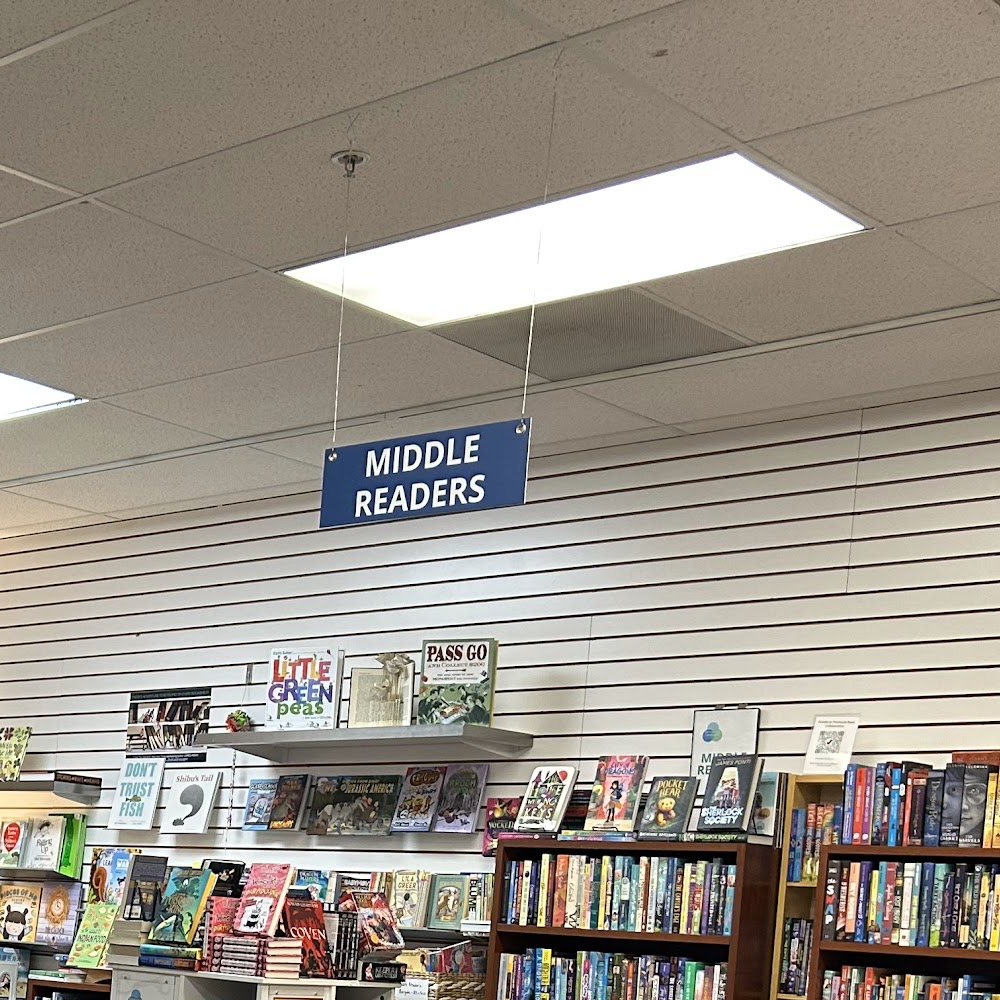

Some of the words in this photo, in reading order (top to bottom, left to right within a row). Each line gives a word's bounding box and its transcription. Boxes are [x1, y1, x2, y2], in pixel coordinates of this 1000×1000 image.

[365, 433, 481, 477] MIDDLE
[354, 474, 486, 518] READERS
[427, 645, 464, 662] PASS
[466, 644, 487, 661] GO
[273, 657, 331, 682] LITTLE
[268, 679, 333, 704] GREEN
[277, 701, 324, 719] peas
[125, 762, 158, 777] DON'T
[604, 767, 637, 775] DRAGONS
[176, 775, 199, 783] Shibu's
[200, 774, 213, 782] Tail
[657, 779, 688, 792] POCKET
[120, 782, 154, 797] TRUST
[659, 788, 681, 799] BEAR
[119, 802, 145, 817] FISH
[524, 807, 553, 818] KEYS
[701, 806, 744, 818] SHERLOCK
[704, 815, 739, 826] SOCIETY
[469, 879, 477, 912] BLUME
[825, 885, 836, 925] SWAP
[290, 926, 327, 940] COVEN
